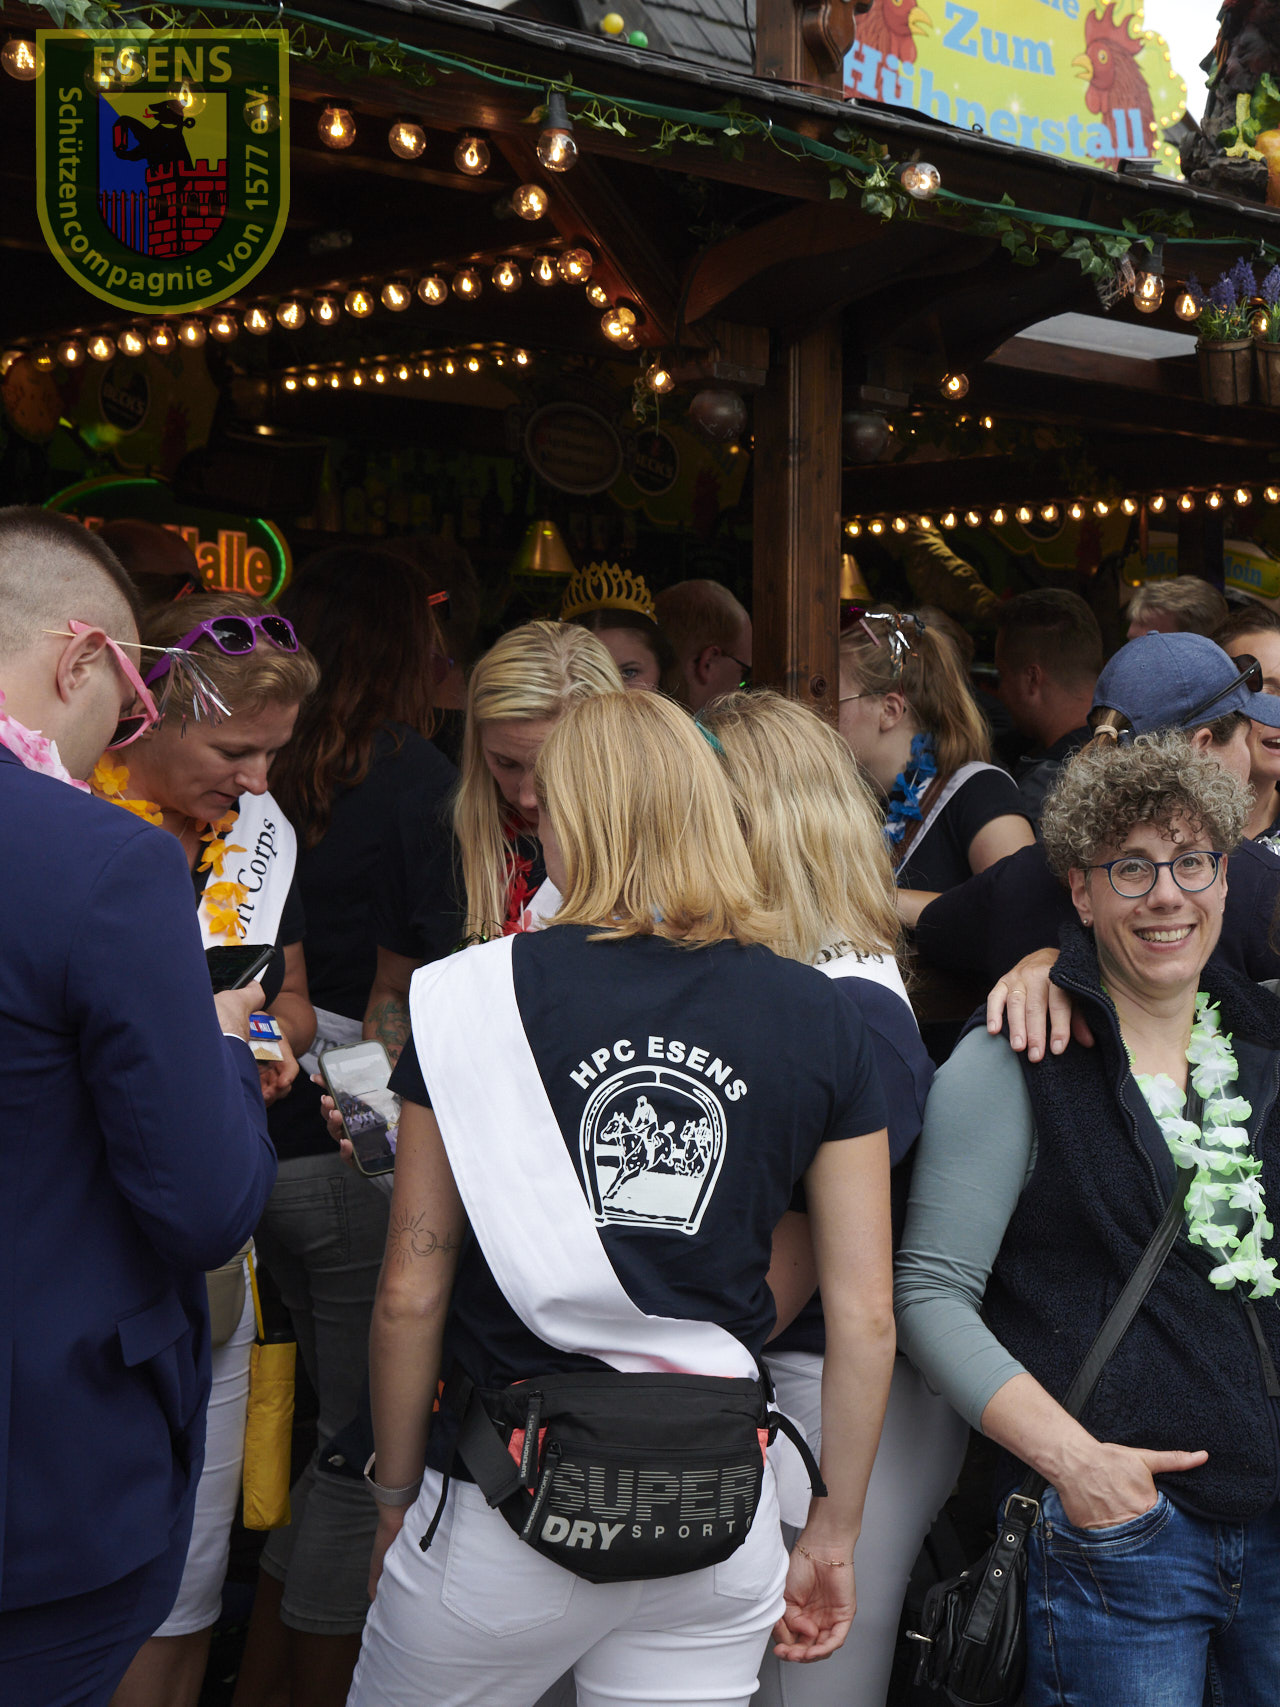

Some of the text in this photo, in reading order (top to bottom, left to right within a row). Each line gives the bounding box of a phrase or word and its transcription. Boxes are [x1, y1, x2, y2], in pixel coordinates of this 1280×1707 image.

[943, 2, 1055, 76] Zum
[843, 40, 1149, 158] Hühnerstall
[237, 818, 278, 893] Corps
[569, 1035, 748, 1102] HPC ESENS
[549, 1462, 758, 1522] SUPER
[540, 1514, 736, 1551] DRY SPORT
